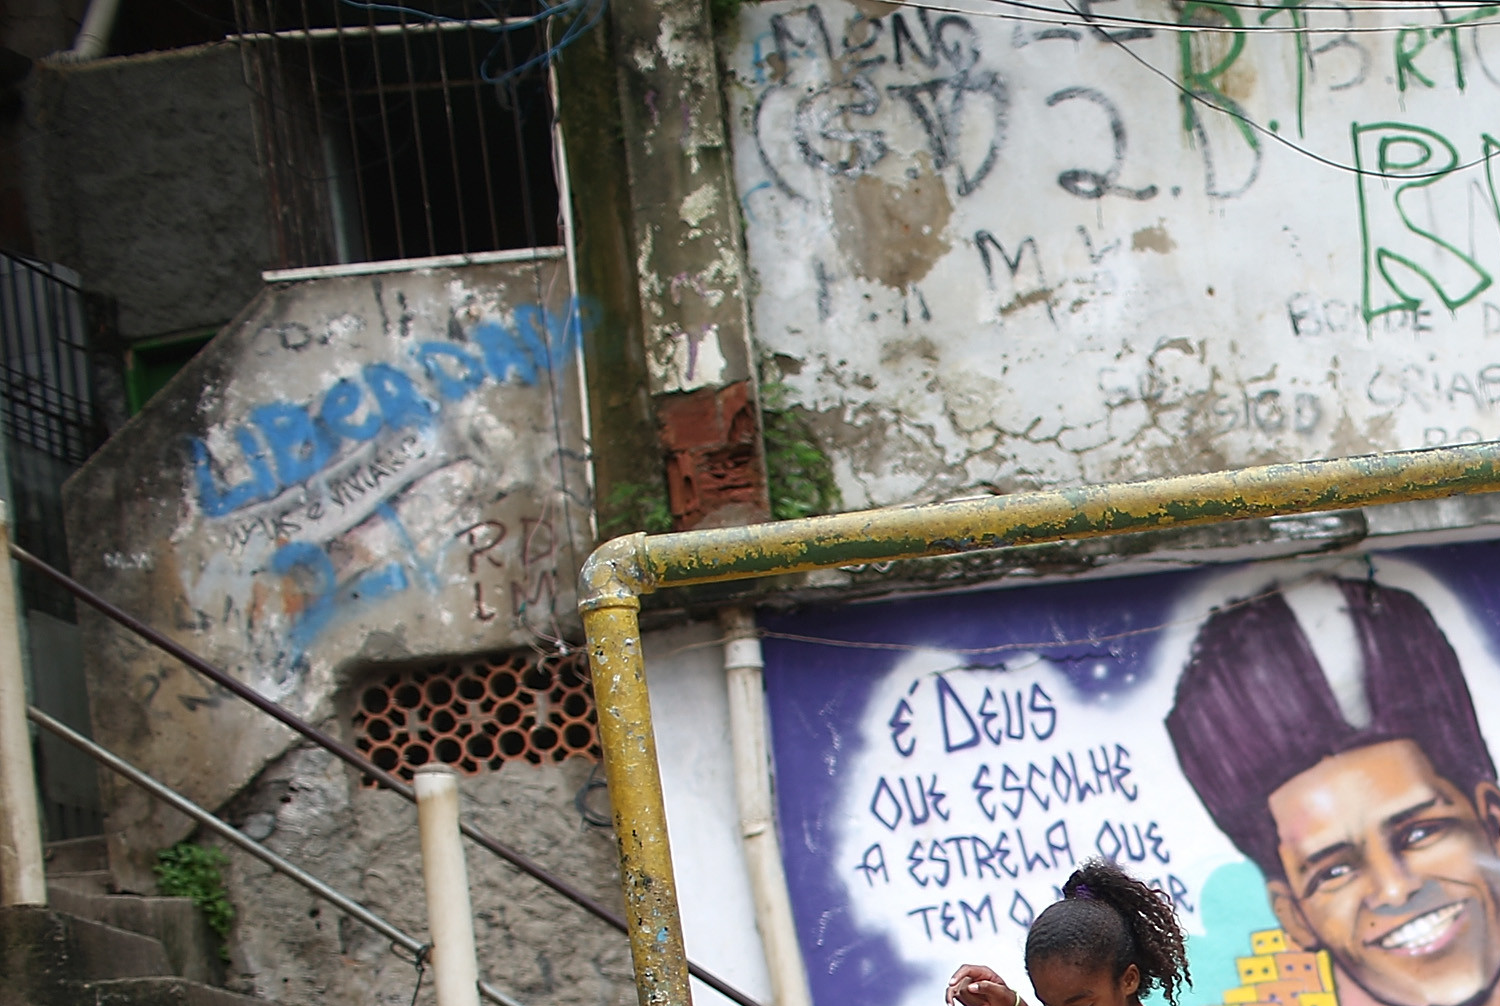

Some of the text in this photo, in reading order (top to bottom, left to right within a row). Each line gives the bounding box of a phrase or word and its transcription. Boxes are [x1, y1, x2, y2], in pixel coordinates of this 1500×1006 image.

[937, 673, 1058, 754] DEUS
[972, 743, 1139, 822] ESCOLHE
[856, 843, 891, 887] A
[908, 819, 1077, 888] ESTRELA
[909, 891, 999, 942] TEM
